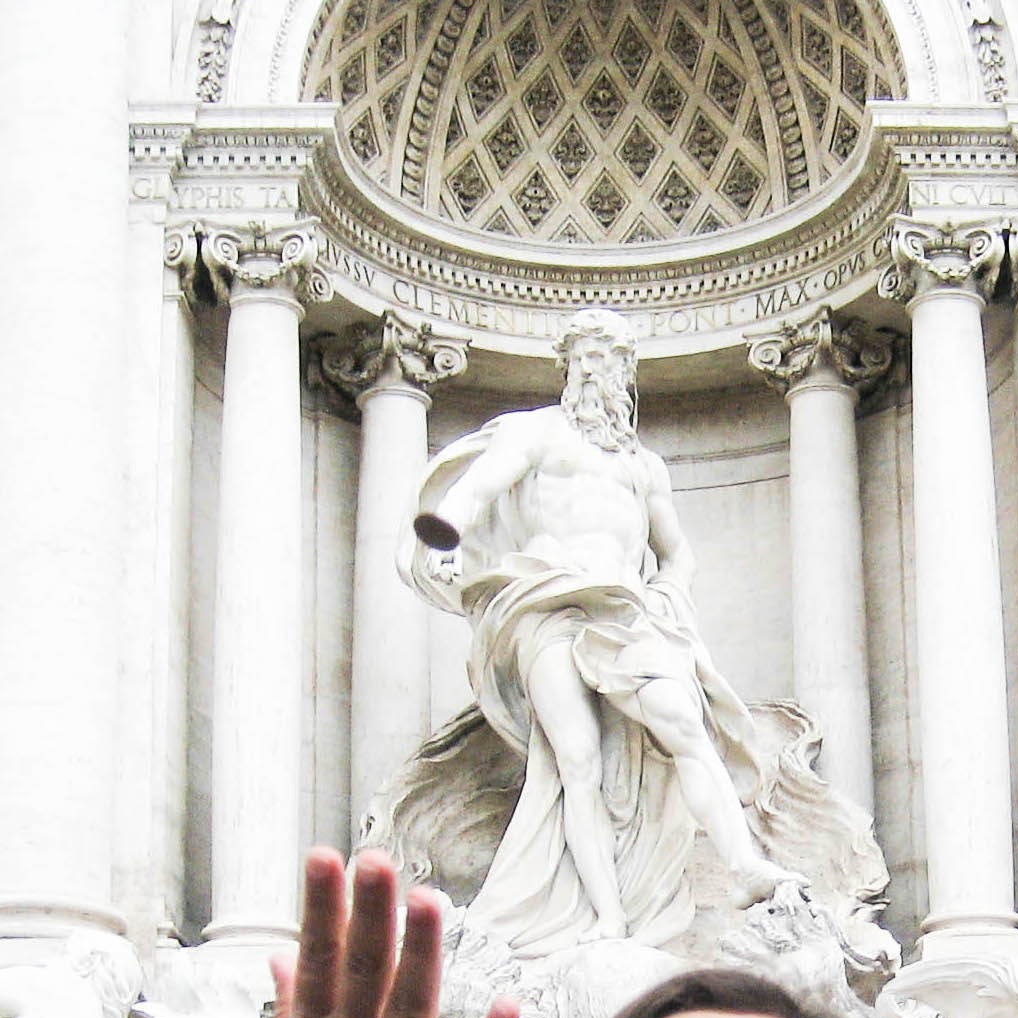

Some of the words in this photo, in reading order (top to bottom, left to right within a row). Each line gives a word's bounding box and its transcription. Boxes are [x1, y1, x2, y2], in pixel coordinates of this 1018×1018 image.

[259, 186, 294, 209] TA
[326, 238, 375, 288] IVSSV
[824, 250, 866, 291] OPVS
